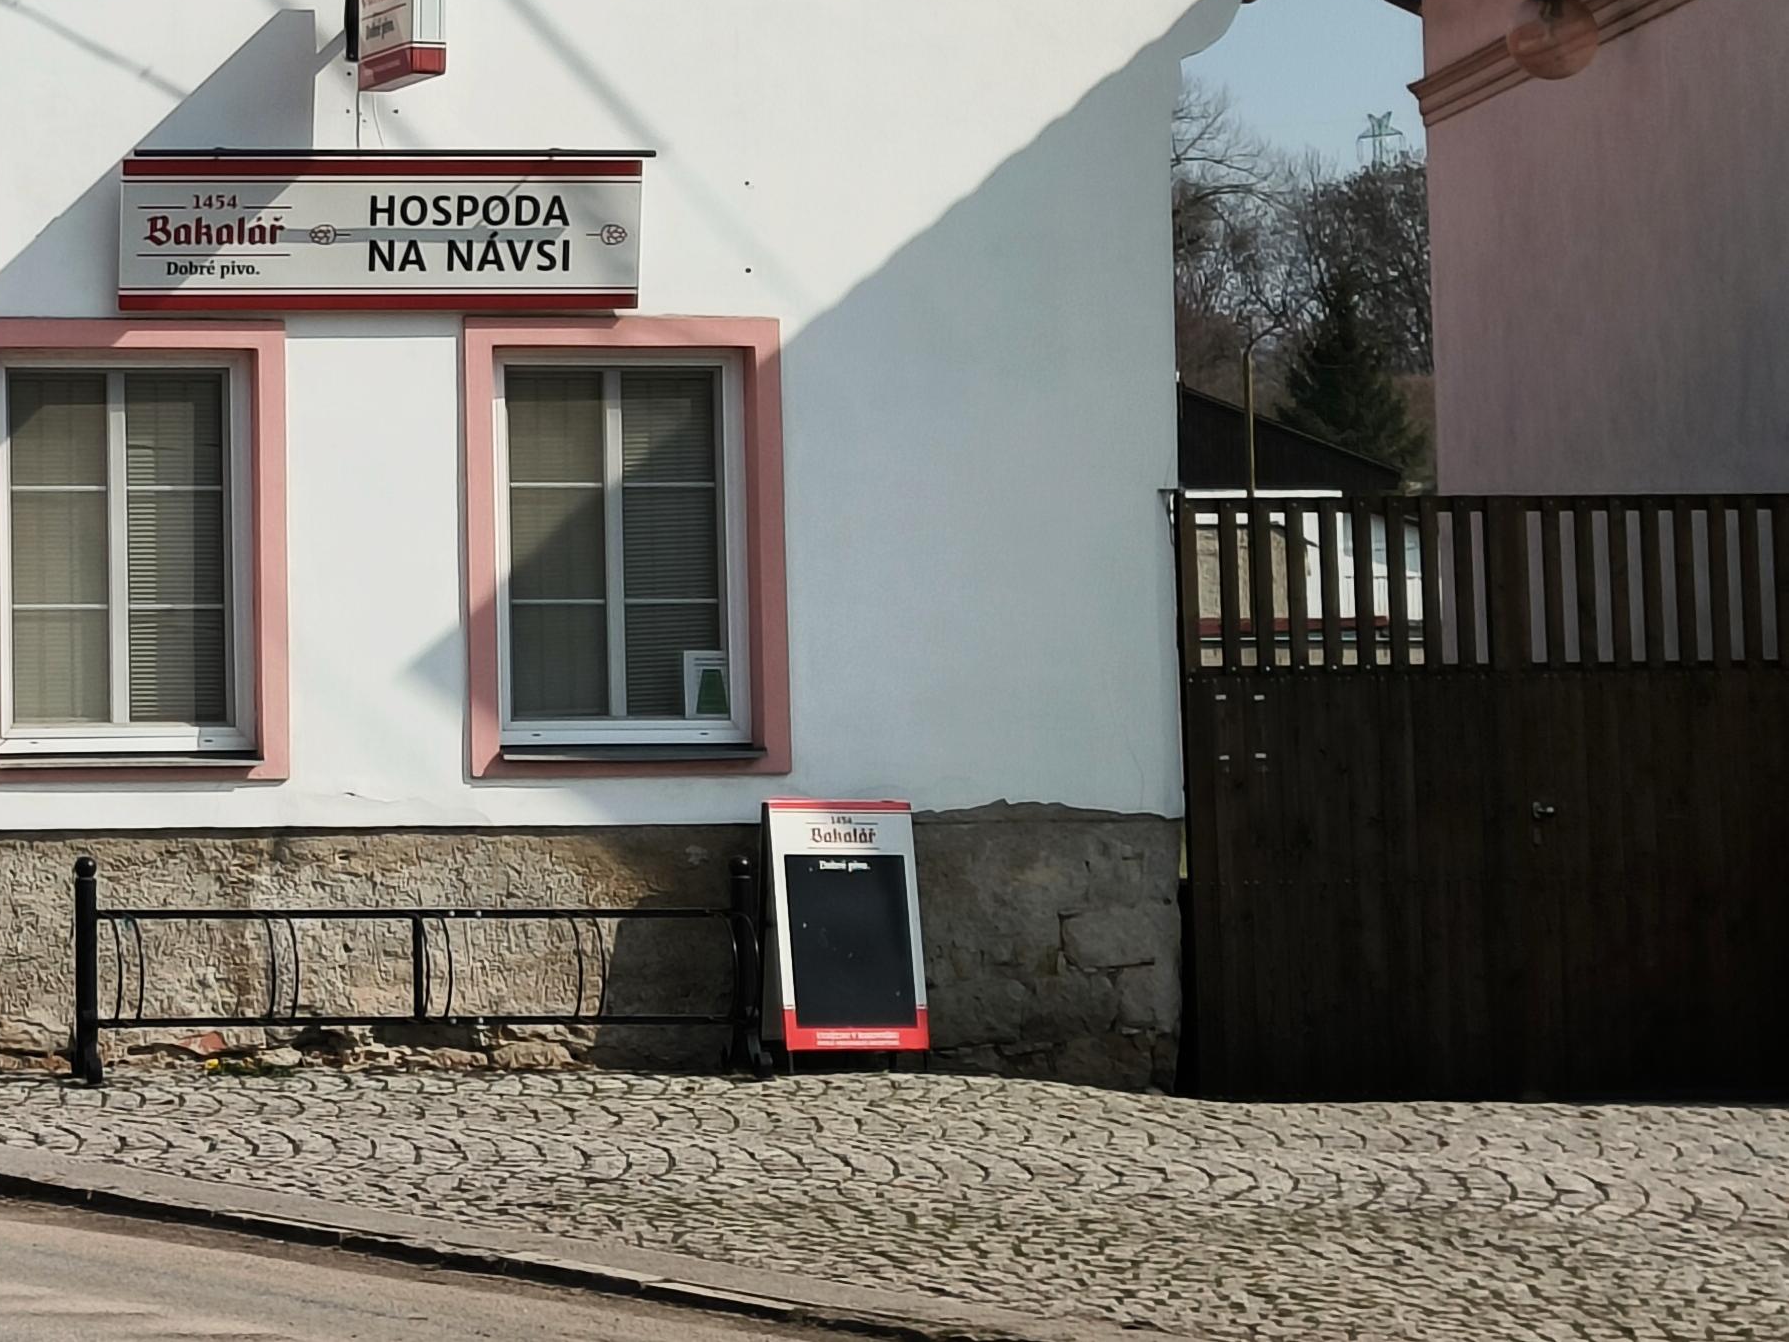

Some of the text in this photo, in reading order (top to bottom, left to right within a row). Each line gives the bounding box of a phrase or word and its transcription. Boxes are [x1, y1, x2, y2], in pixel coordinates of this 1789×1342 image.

[193, 194, 238, 210] 1454
[368, 194, 571, 228] HOSPODA
[144, 215, 285, 246] Bakalář
[367, 231, 571, 272] NA NÁVSI
[165, 260, 261, 280] Dobré pivo.
